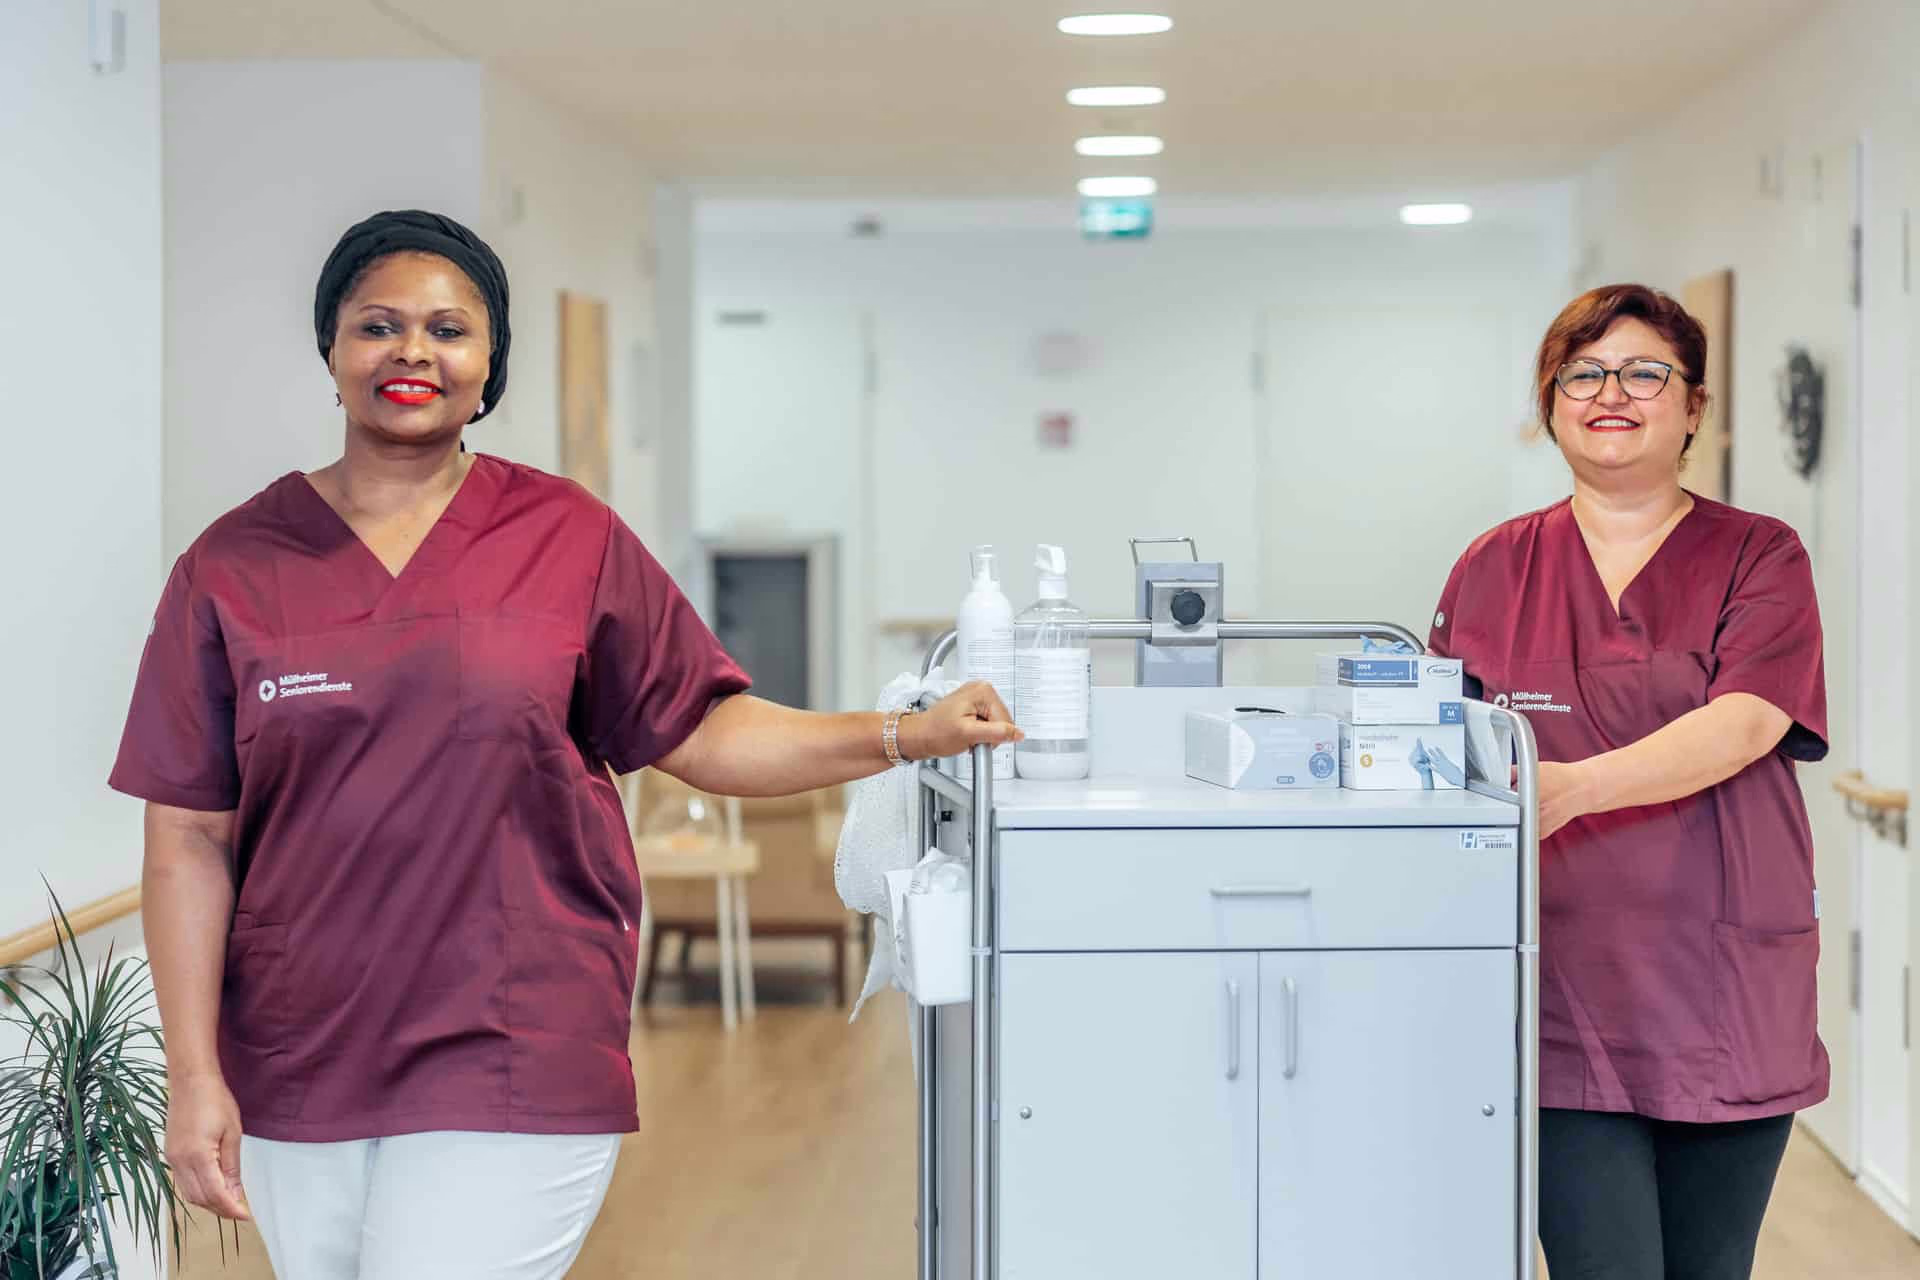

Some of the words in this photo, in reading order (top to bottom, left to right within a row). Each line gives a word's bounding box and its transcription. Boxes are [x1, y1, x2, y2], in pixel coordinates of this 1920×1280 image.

[279, 672, 328, 686] Mülheimer
[279, 681, 353, 698] Seniorendienste
[1512, 691, 1553, 701] Mülheimer
[1511, 701, 1572, 713] Seniorendienste
